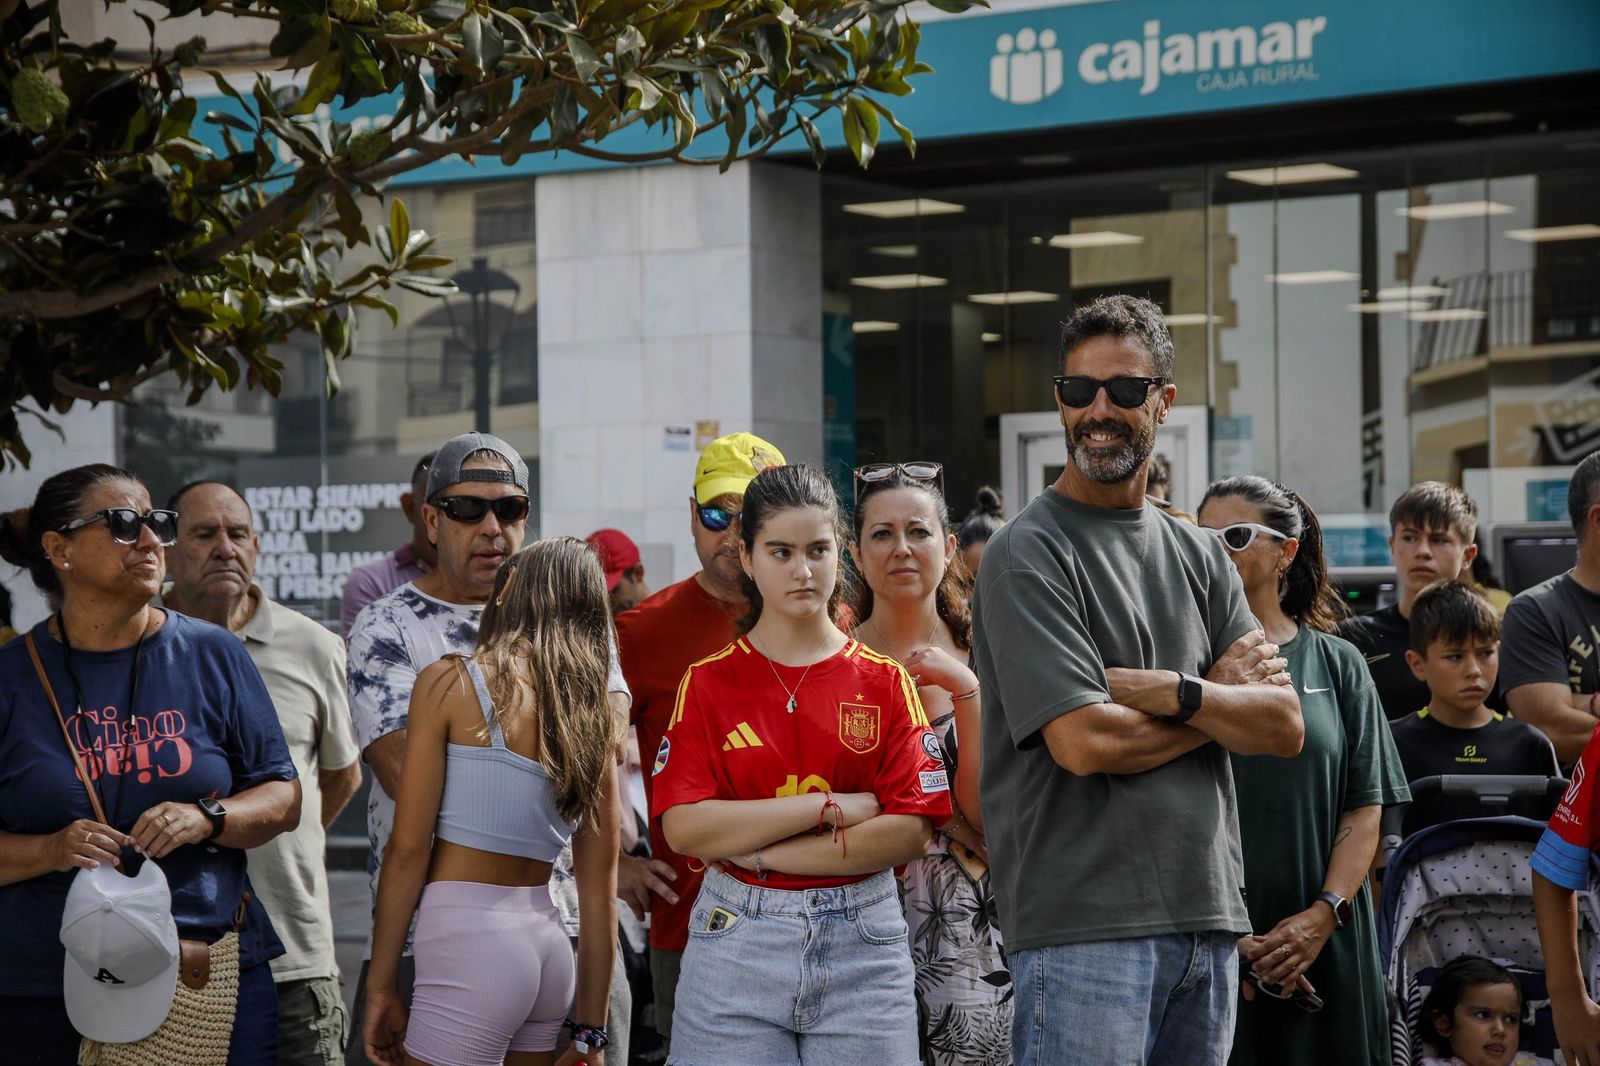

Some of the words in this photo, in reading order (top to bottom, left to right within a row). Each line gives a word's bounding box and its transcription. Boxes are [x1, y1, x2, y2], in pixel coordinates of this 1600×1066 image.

[1078, 15, 1327, 96] cajamar
[1196, 71, 1248, 93] CAJA
[1253, 63, 1319, 85] RURAL
[266, 508, 297, 532] TU
[300, 507, 364, 532] LADO
[259, 531, 309, 553] ARA
[65, 706, 186, 752] Ciao
[94, 968, 125, 985] A
